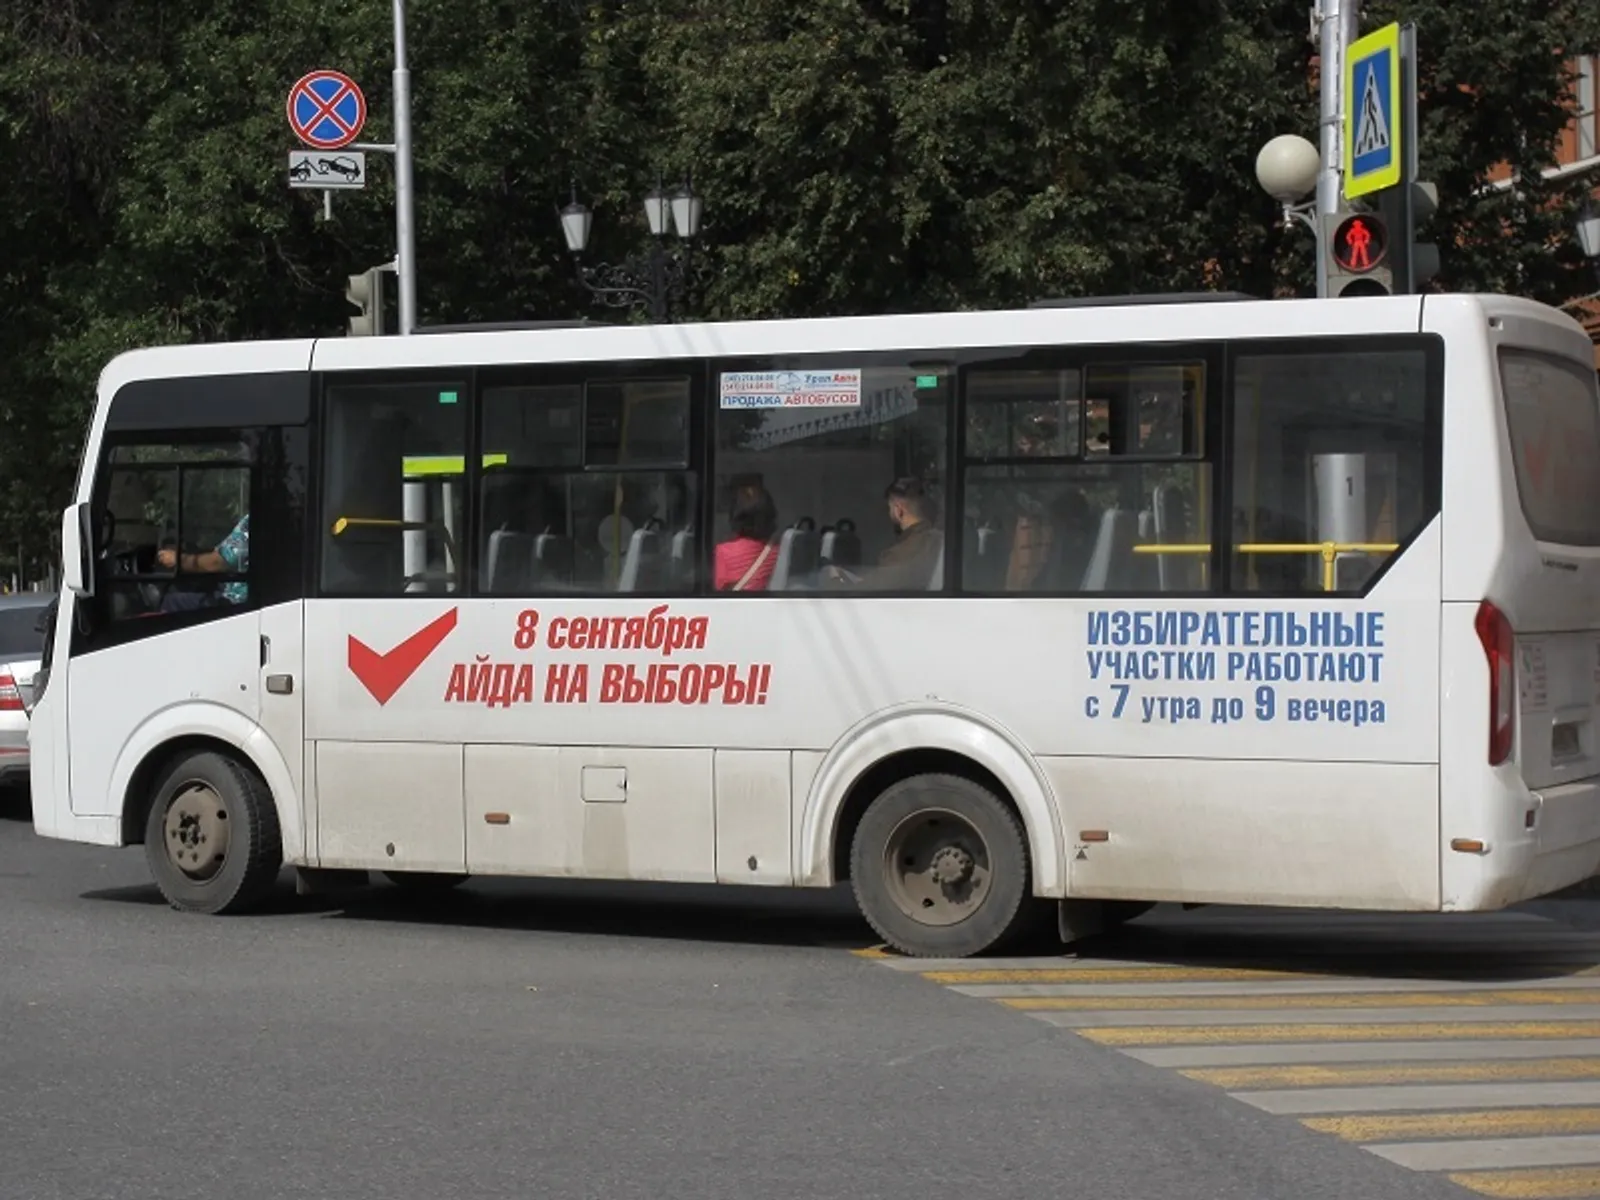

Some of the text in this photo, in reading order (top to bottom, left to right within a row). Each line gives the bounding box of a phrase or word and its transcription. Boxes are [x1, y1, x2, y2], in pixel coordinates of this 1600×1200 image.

[723, 394, 857, 406] ПРОДАЖА АВТОБУСОВ
[514, 604, 708, 656] 8 сентября
[1087, 611, 1384, 647] ИЗБИРАТЕЛЬНЫЕ
[444, 654, 771, 708] АЙДА НА ВЫБОРЫ!
[1087, 651, 1383, 682] УЧАСТКИ РАБОТАЮТ
[1085, 684, 1385, 727] с 7 утра до 9 вечера
